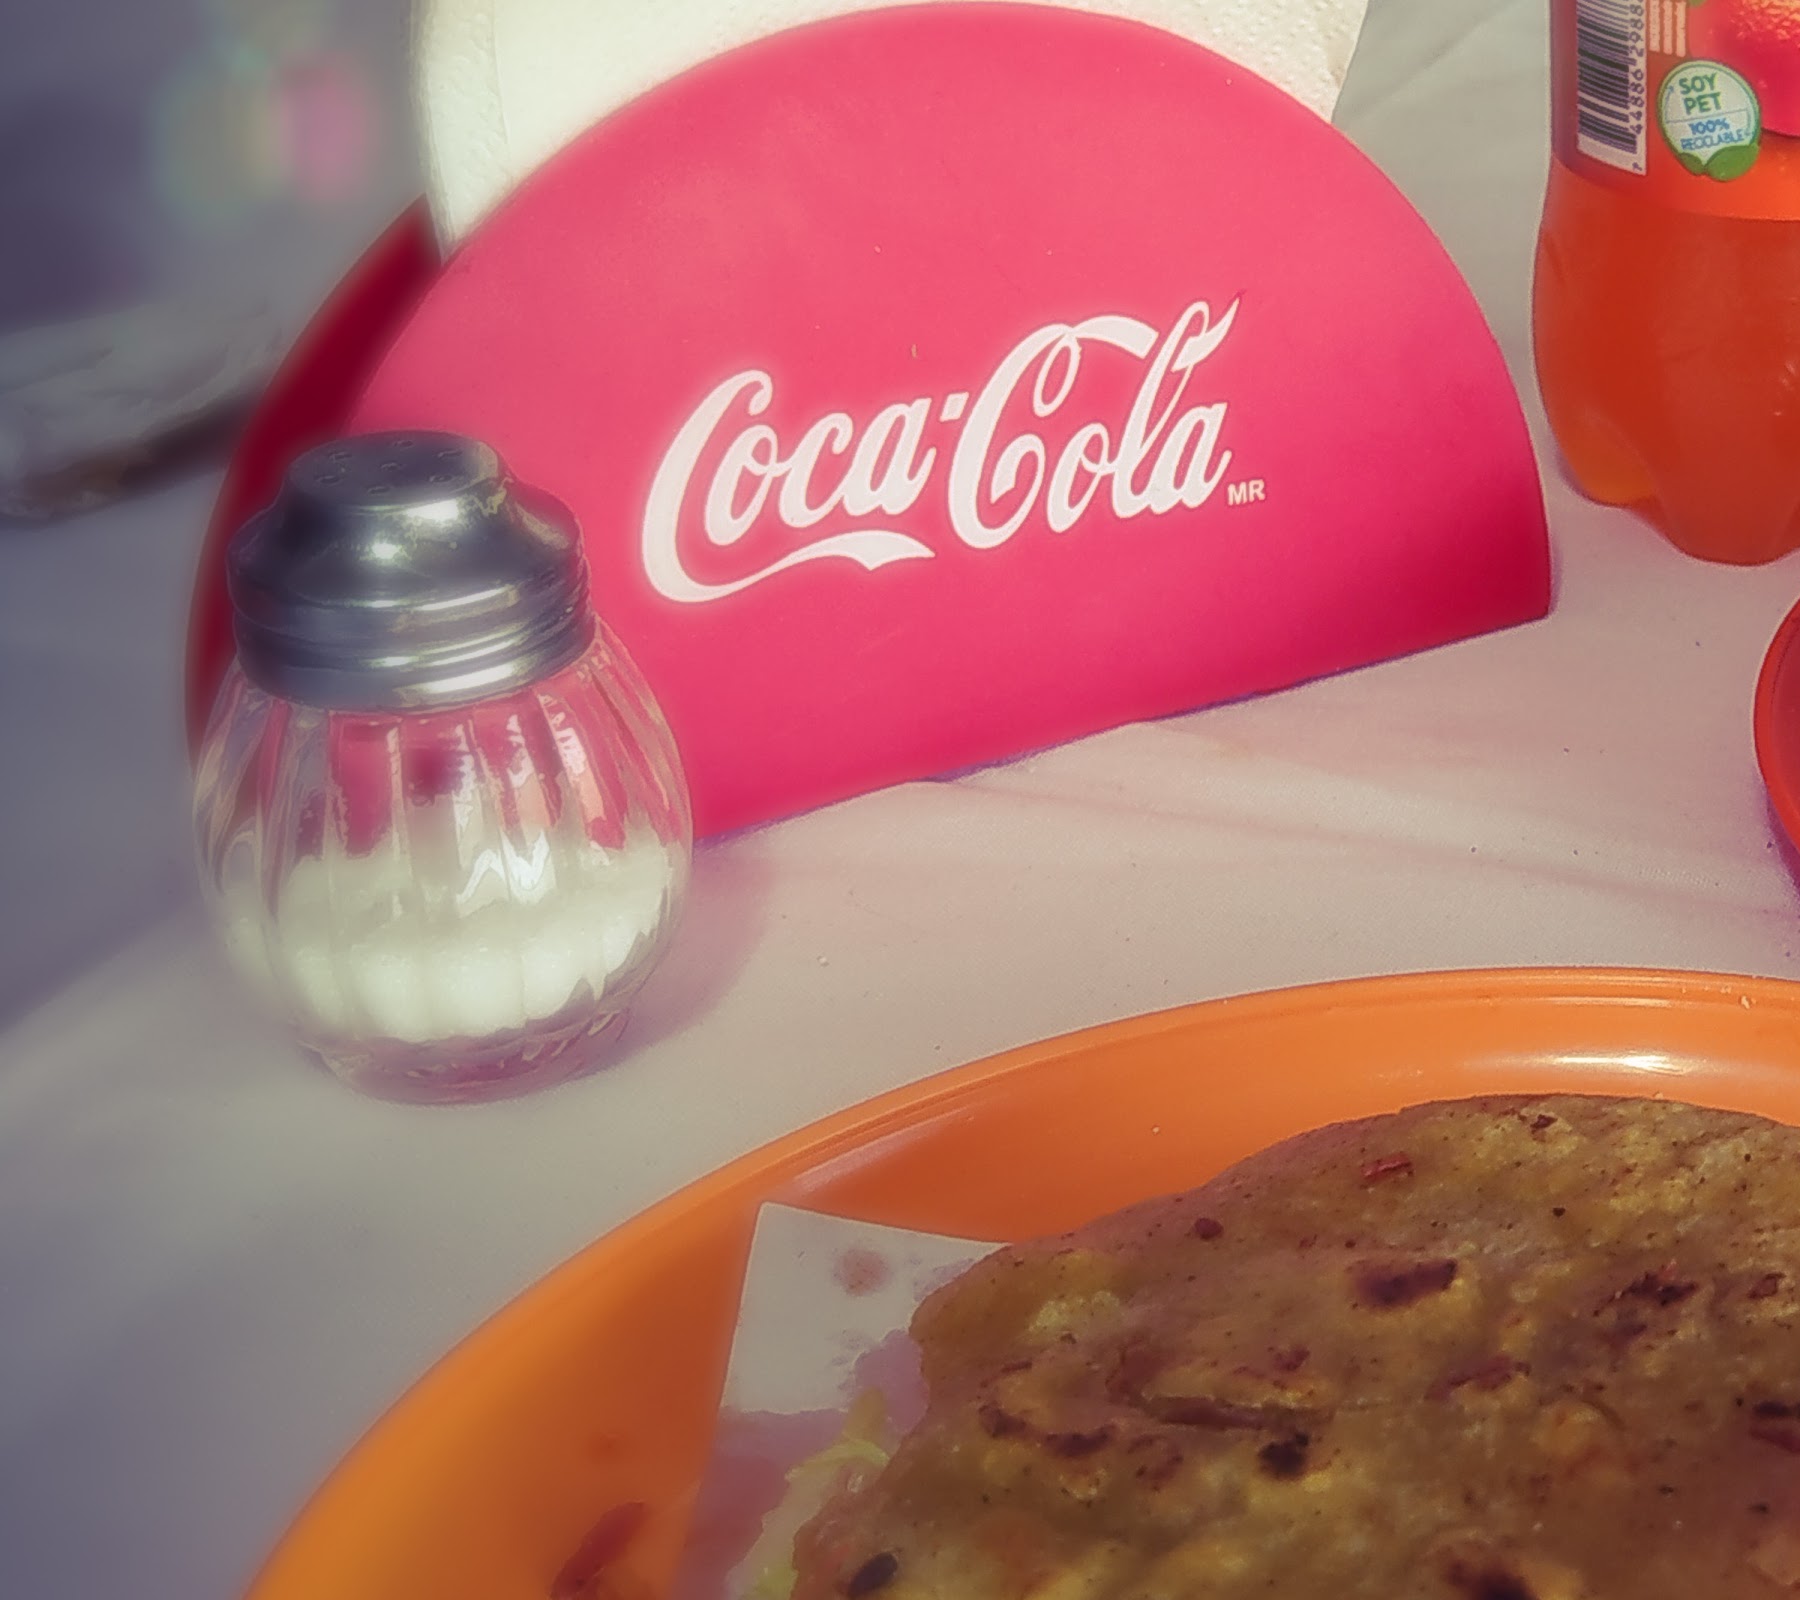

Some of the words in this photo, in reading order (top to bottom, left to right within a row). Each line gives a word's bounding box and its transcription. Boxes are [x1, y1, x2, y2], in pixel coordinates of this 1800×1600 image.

[1678, 72, 1717, 95] SOY
[1683, 92, 1721, 115] PET
[1688, 118, 1730, 135] 100%
[641, 297, 1240, 603] Coca-Cola
[1227, 479, 1266, 506] MR
